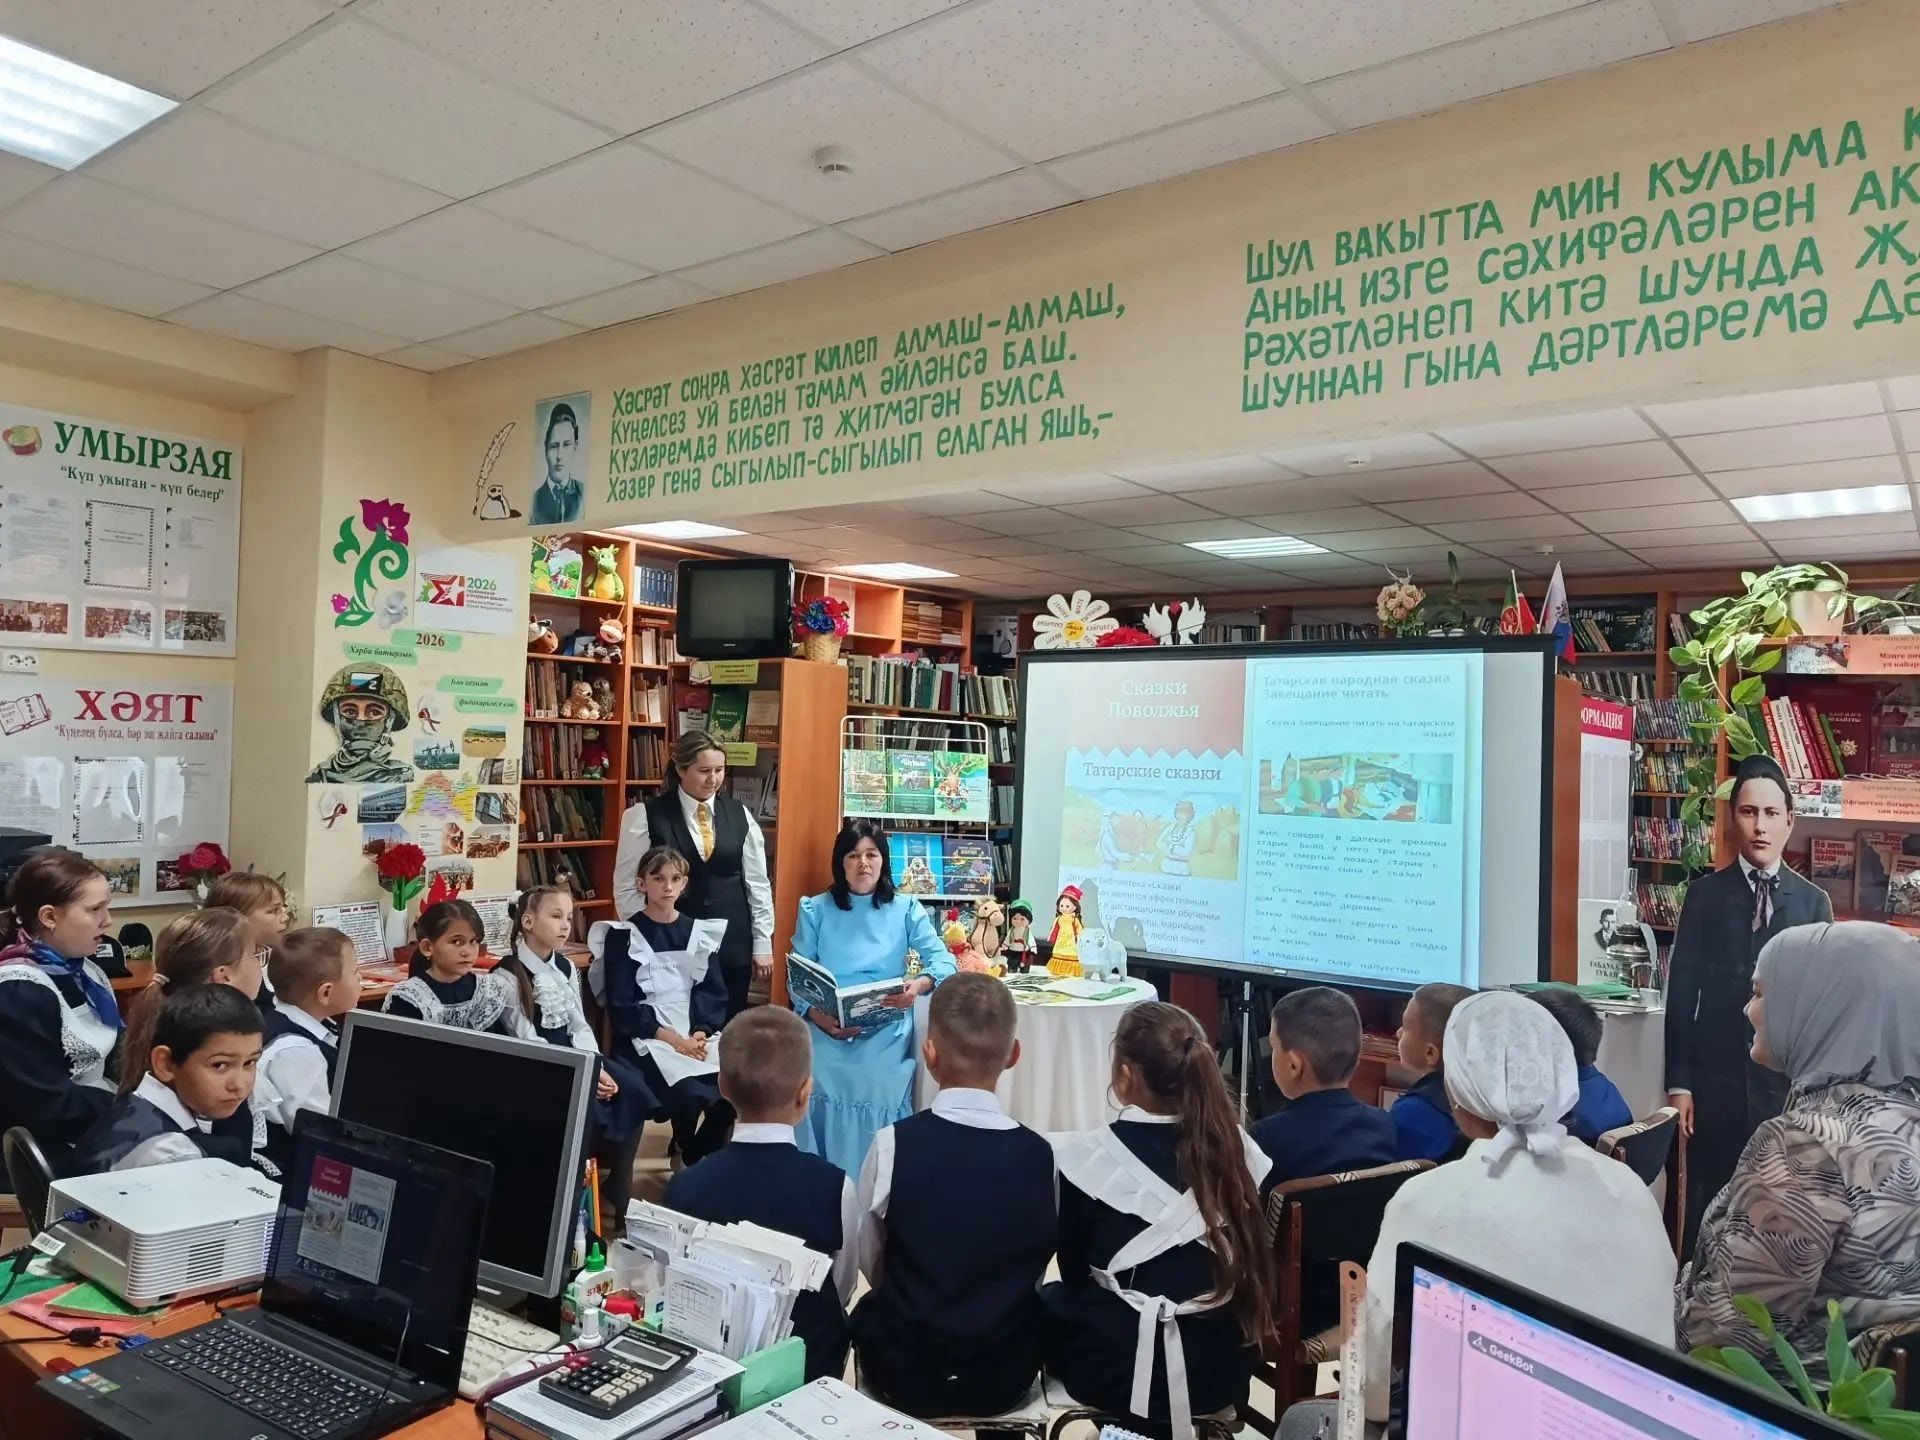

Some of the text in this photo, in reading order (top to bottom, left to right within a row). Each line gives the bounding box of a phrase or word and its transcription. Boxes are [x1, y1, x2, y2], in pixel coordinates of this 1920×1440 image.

[1246, 239, 1314, 284] ШУЛ
[1335, 199, 1503, 266] ВАКЫТТА
[1530, 171, 1620, 229] МИН
[1648, 120, 1866, 201] КУЛЫМА
[1245, 278, 1345, 328] АНЫҢ
[1360, 257, 1449, 308] ИЗГЕ
[1478, 182, 1815, 284] СӘХИФӘЛӘРЕН
[1244, 298, 1473, 371] РӘХӘТЛӘНЕП
[1499, 273, 1606, 328] КИТӘ
[1638, 236, 1824, 306] ШУНДА
[1242, 358, 1383, 413] ШУННАН
[1404, 340, 1501, 389] ГЫНА
[1528, 288, 1828, 377] ДӘРТЛӘРЕМӘ
[611, 330, 1077, 446] КҮҢЕЛСЕЗ УЙ БЕЛӘН ТӘМАМ ӘЙЛӘНСӘ БАШ.
[612, 382, 672, 418] ХӘСРӘТ
[680, 369, 731, 403] СОҢРА
[740, 352, 807, 391] ХӘСРӘТ
[814, 335, 878, 375] КИЛЕП
[608, 369, 1065, 475] КҮЗЛӘРЕМДӘ КИБЕП ТӘ ҖИТМӘГӘН БУЛСА
[53, 420, 232, 480] УМЫРЗАЯ
[606, 474, 655, 503] ХӘЗЕР
[662, 467, 701, 497] ГЕНӘ
[936, 412, 1027, 458] ЕЛАГАН
[98, 472, 147, 491] укыган
[160, 482, 183, 497] күп
[467, 577, 497, 591] 2026
[416, 632, 445, 647] 2026
[1121, 680, 1188, 696] Сказки
[1264, 673, 1451, 687] Татарская народная сказка
[1264, 689, 1389, 701] Завещание читать
[73, 689, 203, 723] ХӘЯТ
[1107, 702, 1200, 719] Поволжья
[1581, 706, 1624, 732] ОРМАЦИЯ
[1083, 762, 1222, 781] Татарские сказки
[1489, 1344, 1534, 1374] GeekBot
